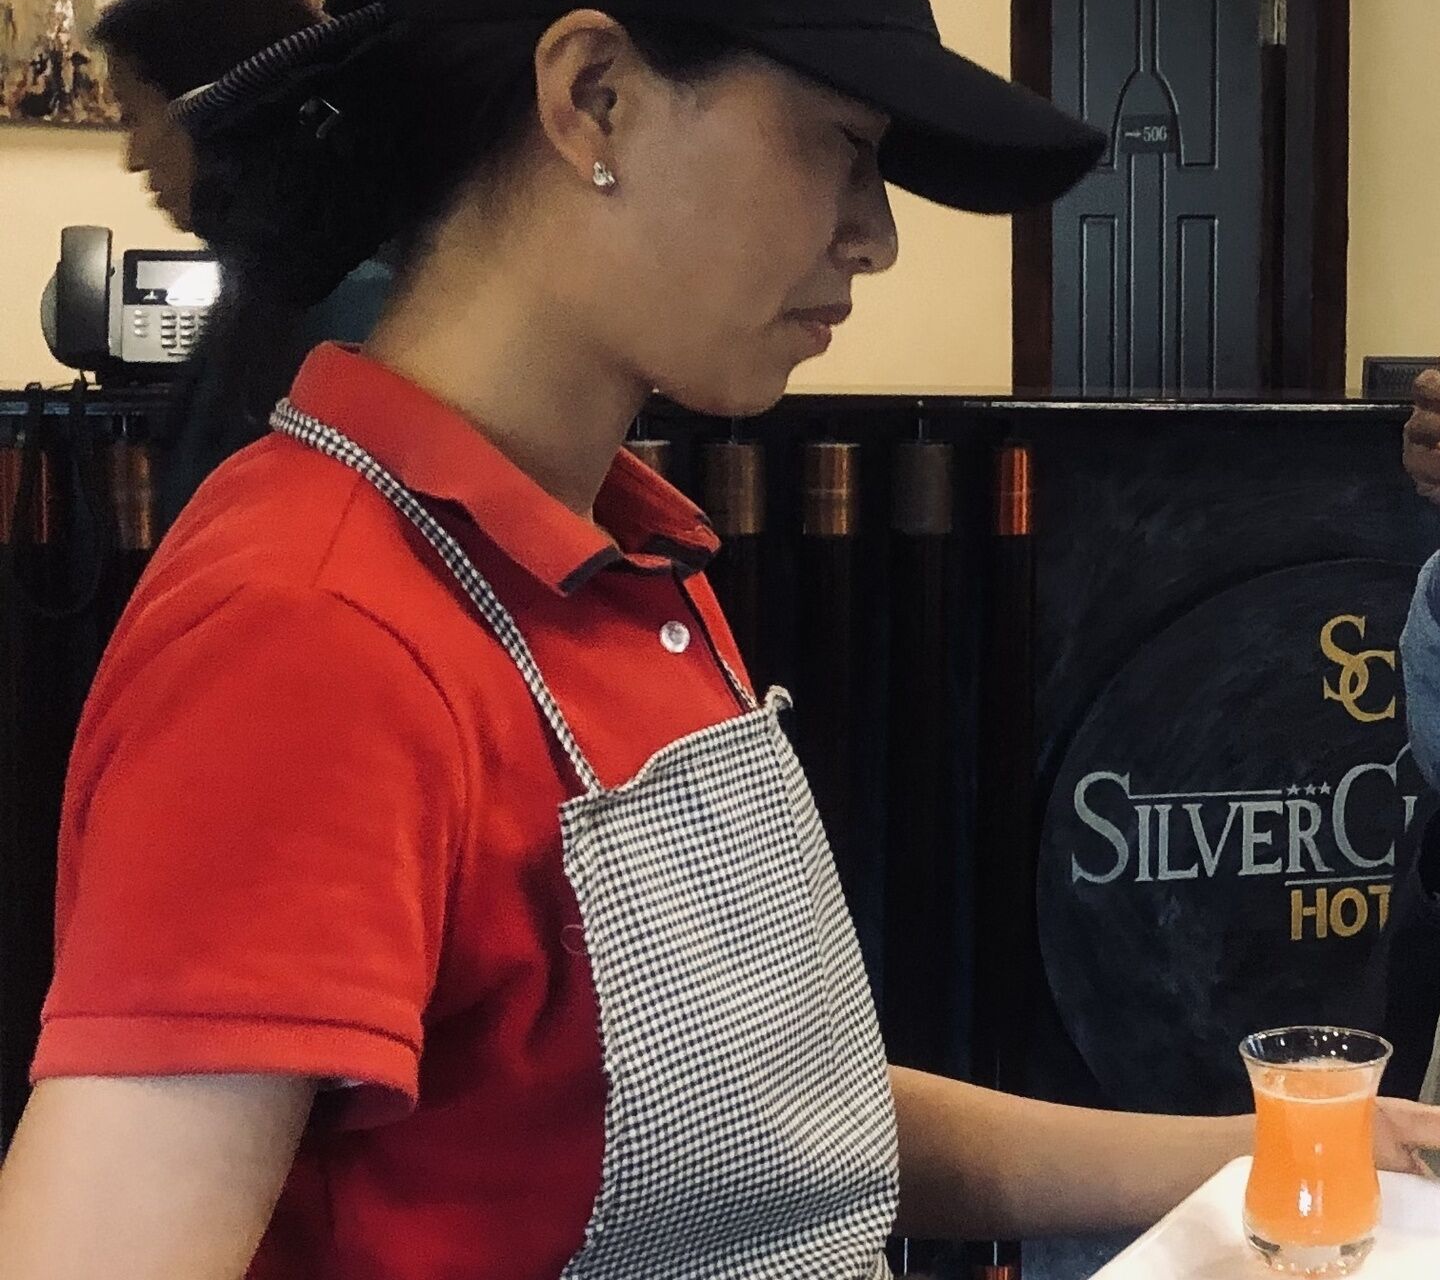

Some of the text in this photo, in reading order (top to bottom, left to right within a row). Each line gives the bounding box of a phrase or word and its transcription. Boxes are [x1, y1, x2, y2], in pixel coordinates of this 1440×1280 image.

[1319, 614, 1396, 722] SC
[1071, 761, 1418, 884] SILVERC
[1289, 884, 1393, 941] HOT
